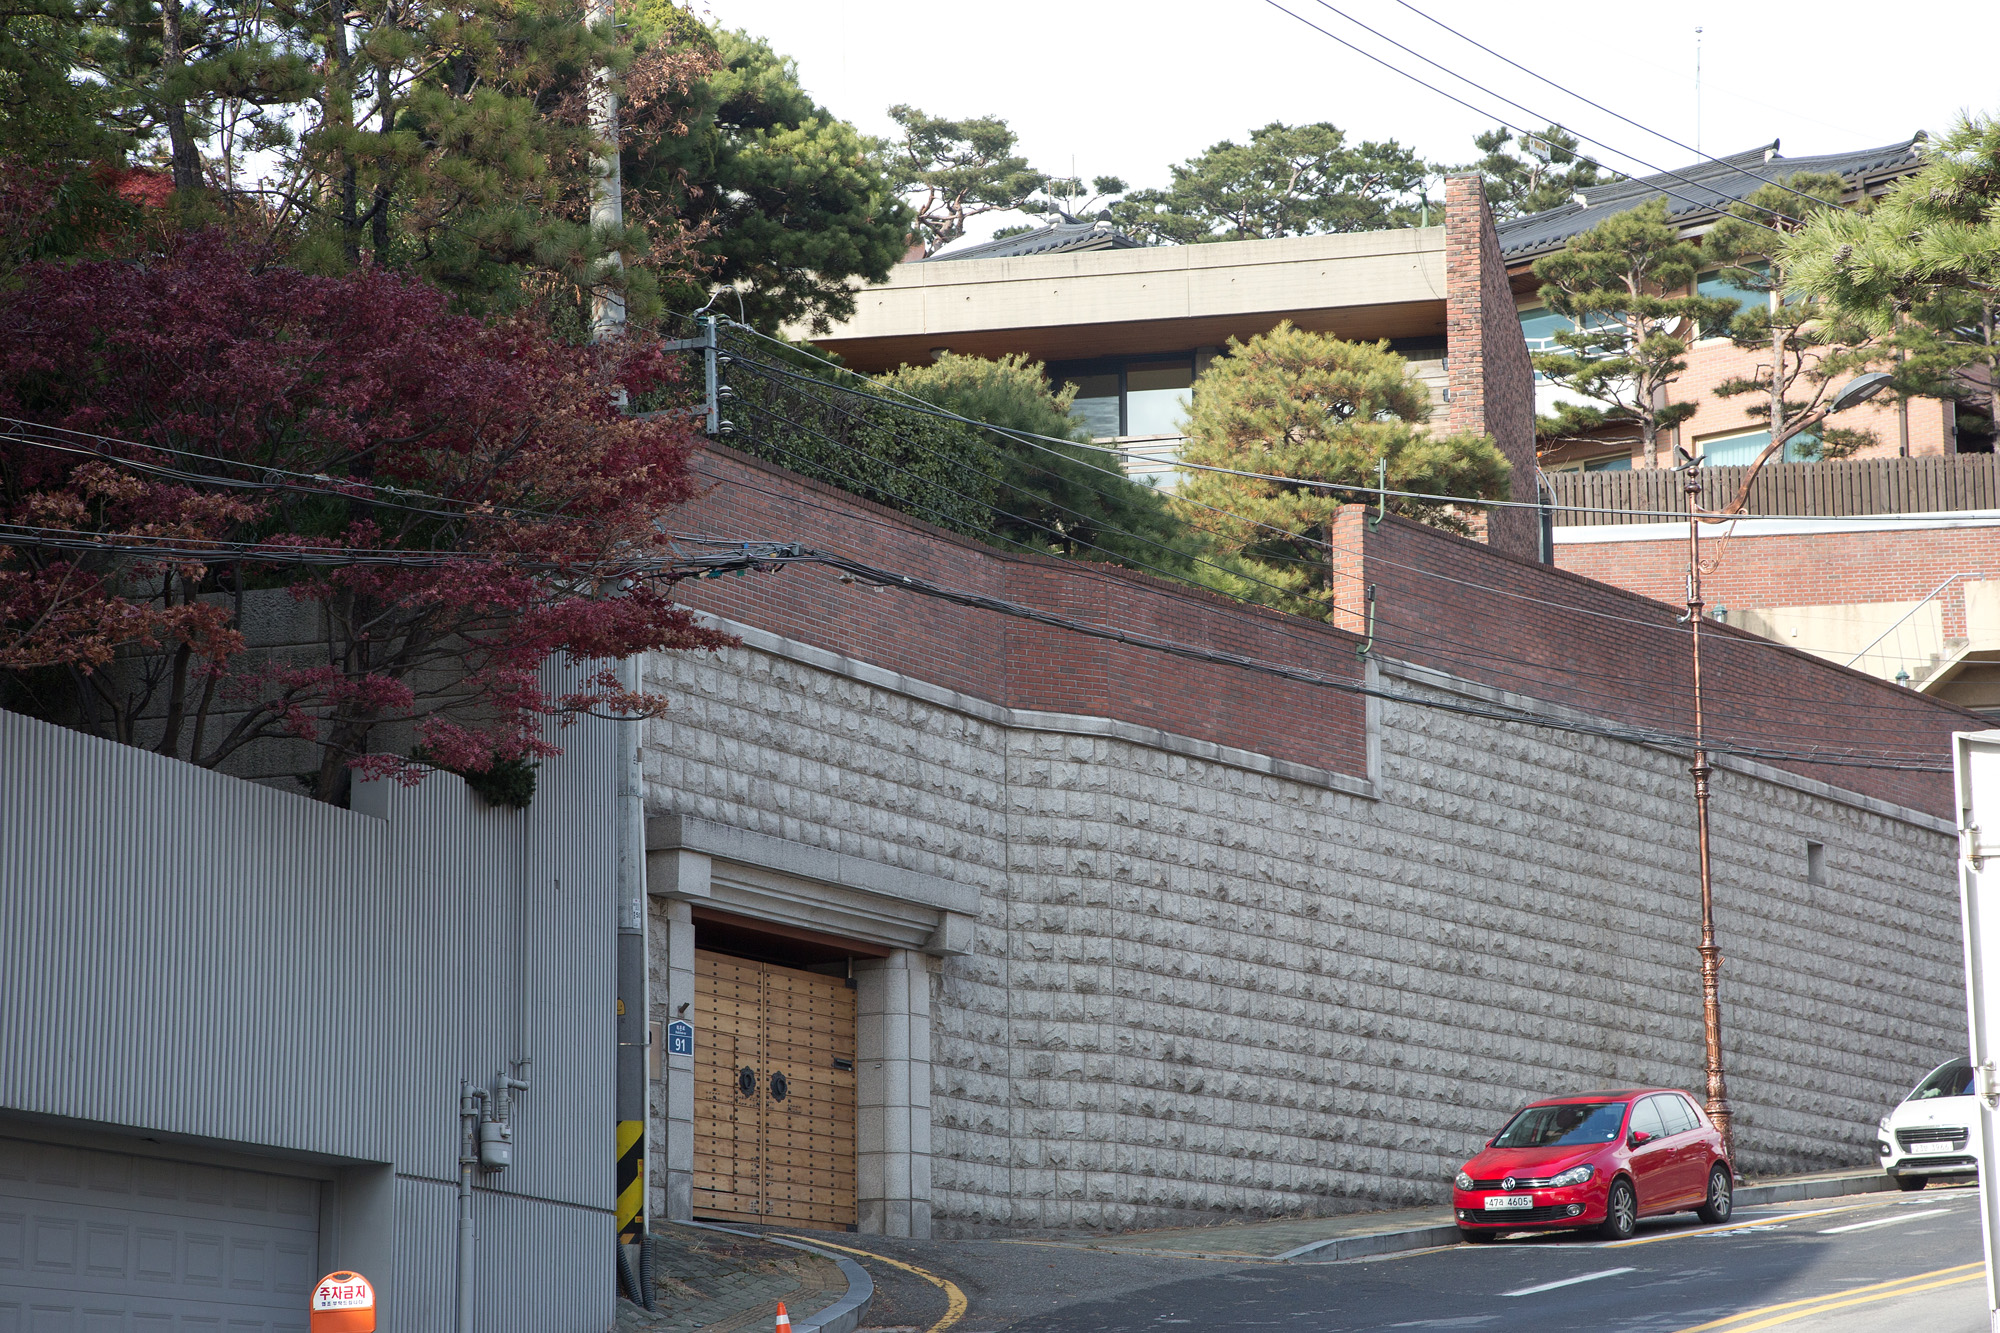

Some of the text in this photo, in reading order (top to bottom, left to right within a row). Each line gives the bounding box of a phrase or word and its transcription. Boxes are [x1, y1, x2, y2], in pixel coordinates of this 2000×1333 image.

[675, 1038, 686, 1052] 91
[1507, 1197, 1529, 1206] 4605
[320, 1285, 366, 1301] 주차금지
